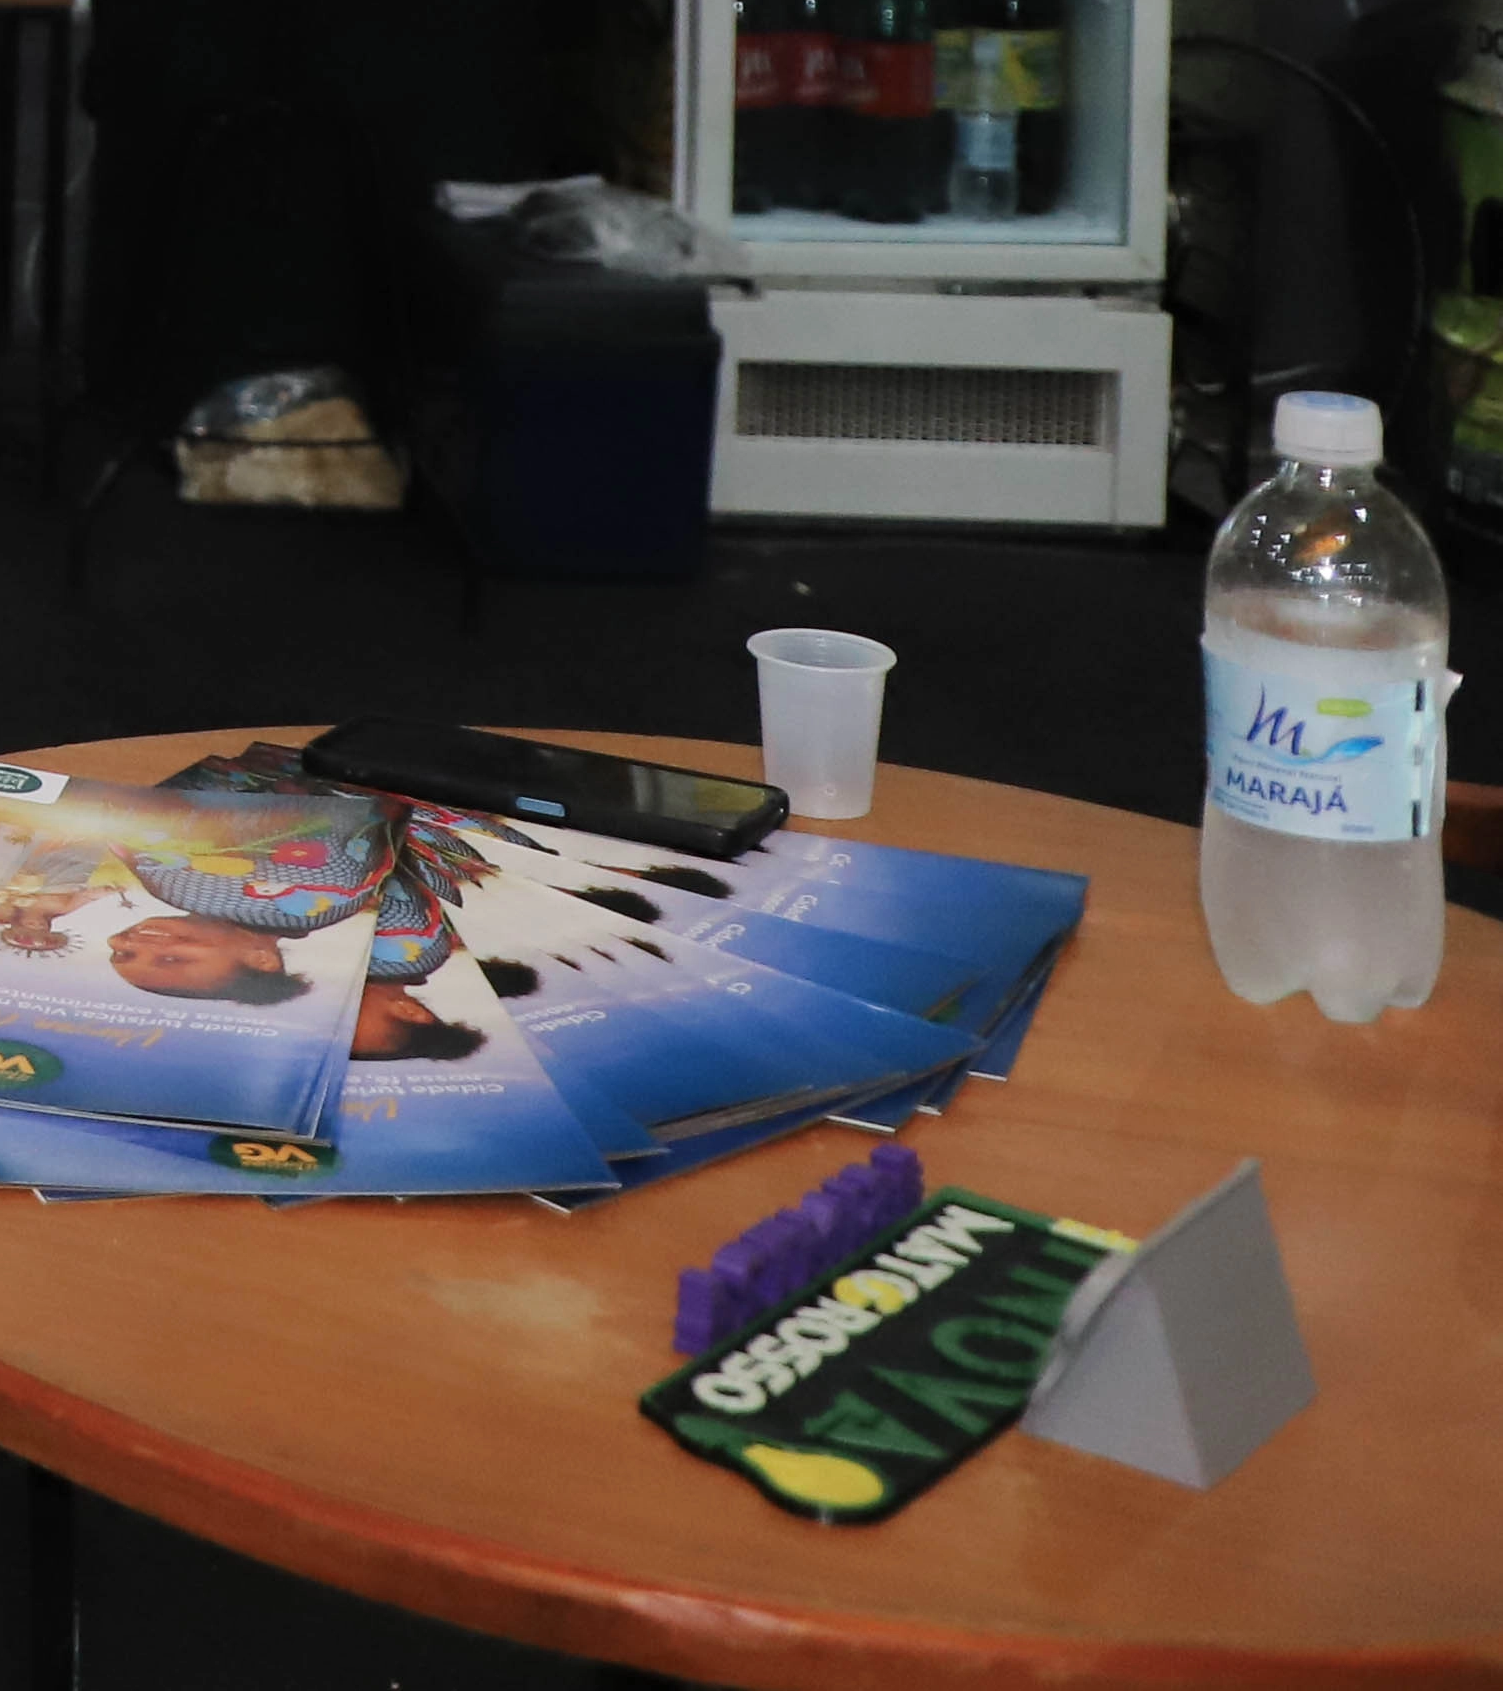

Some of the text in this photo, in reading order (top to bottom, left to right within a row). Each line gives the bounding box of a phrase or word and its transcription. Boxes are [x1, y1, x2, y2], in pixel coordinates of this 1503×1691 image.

[1226, 766, 1348, 815] MARAJÁ
[18, 1000, 68, 1017] Viva
[189, 1021, 279, 1037] Cidade
[410, 1082, 505, 1097] Cidade
[232, 1142, 319, 1165] VG
